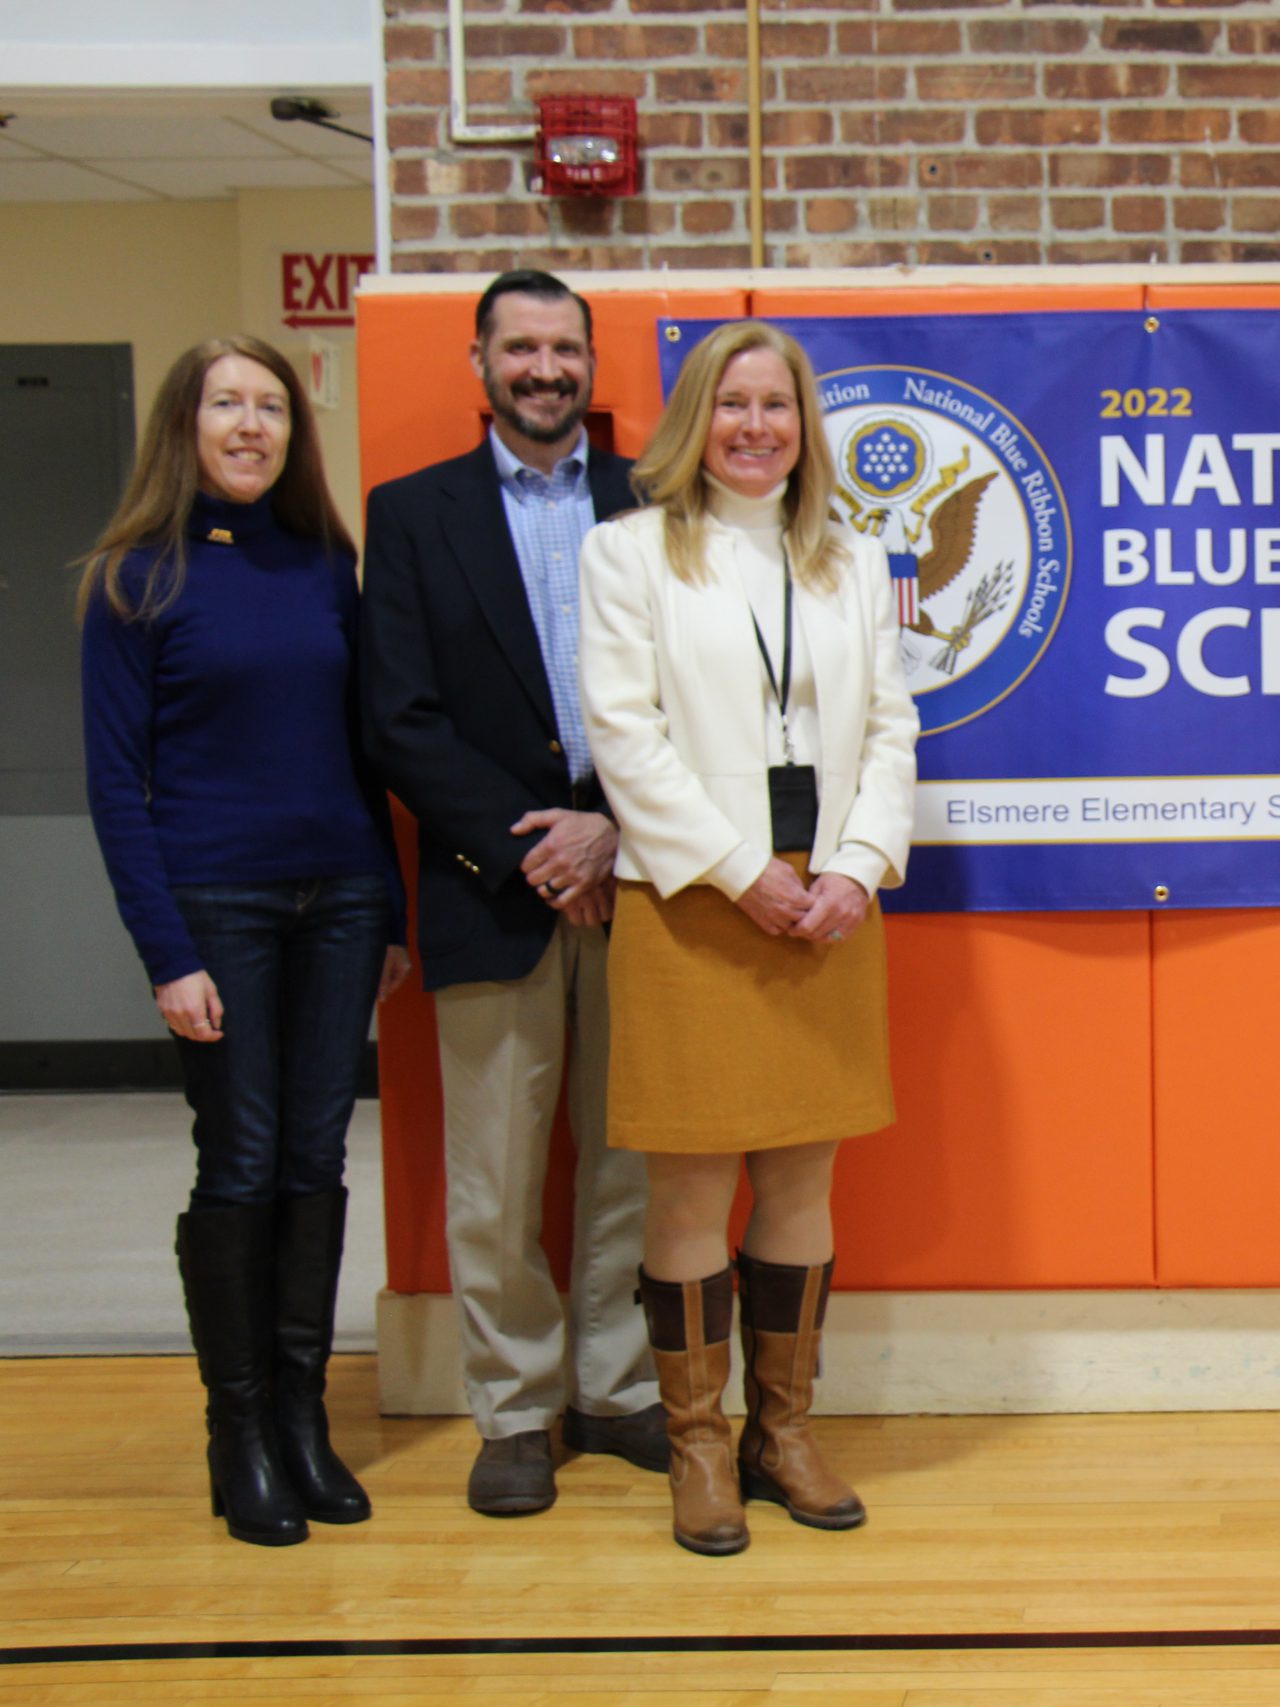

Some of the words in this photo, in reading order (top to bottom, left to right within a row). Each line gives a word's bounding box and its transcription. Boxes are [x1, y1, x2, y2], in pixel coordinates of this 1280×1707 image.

[282, 253, 376, 311] EXIT
[903, 376, 996, 433] National
[1099, 387, 1193, 418] 2022
[988, 421, 1028, 472] Blue
[1021, 469, 1057, 553] Ribbon
[1018, 557, 1061, 638] Schools
[946, 799, 1070, 825] Elsmere
[1081, 797, 1256, 826] Elementary
